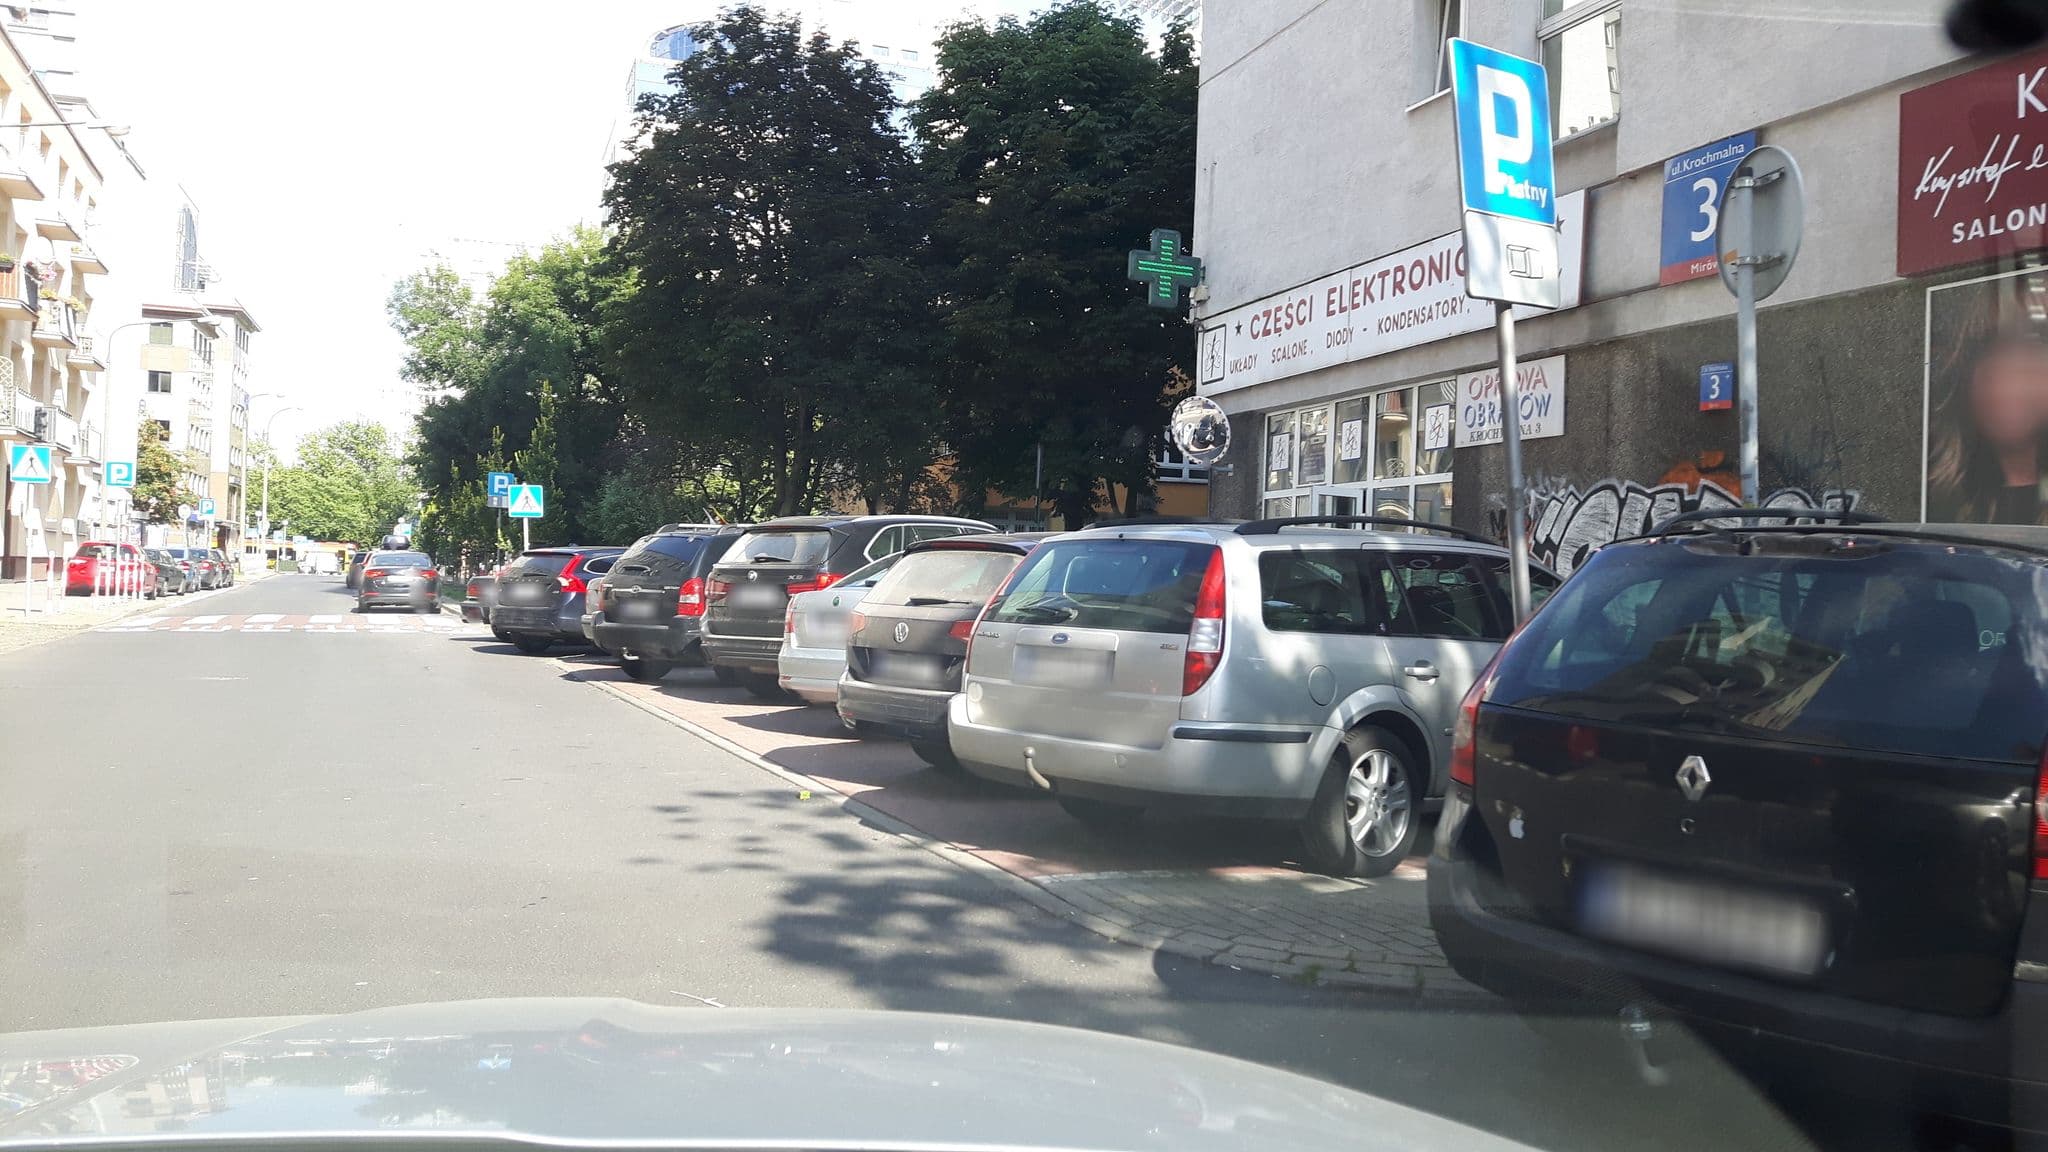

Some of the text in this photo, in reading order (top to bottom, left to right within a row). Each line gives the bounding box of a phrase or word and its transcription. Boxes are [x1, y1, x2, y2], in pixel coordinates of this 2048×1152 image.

[2018, 66, 2048, 119] K
[1477, 64, 1533, 194] P
[1690, 177, 1718, 242] 3
[1952, 203, 2047, 244] SALON
[1249, 294, 1313, 340] CZĘŚCI
[1229, 353, 1258, 375] UKŁADY
[1326, 326, 1355, 349] DIODY
[1468, 364, 1549, 401] OPRWA
[1709, 374, 1720, 400] 3
[1464, 392, 1552, 429] OBRÓW
[1469, 425, 1532, 442] KROCHNA
[493, 475, 509, 493] P
